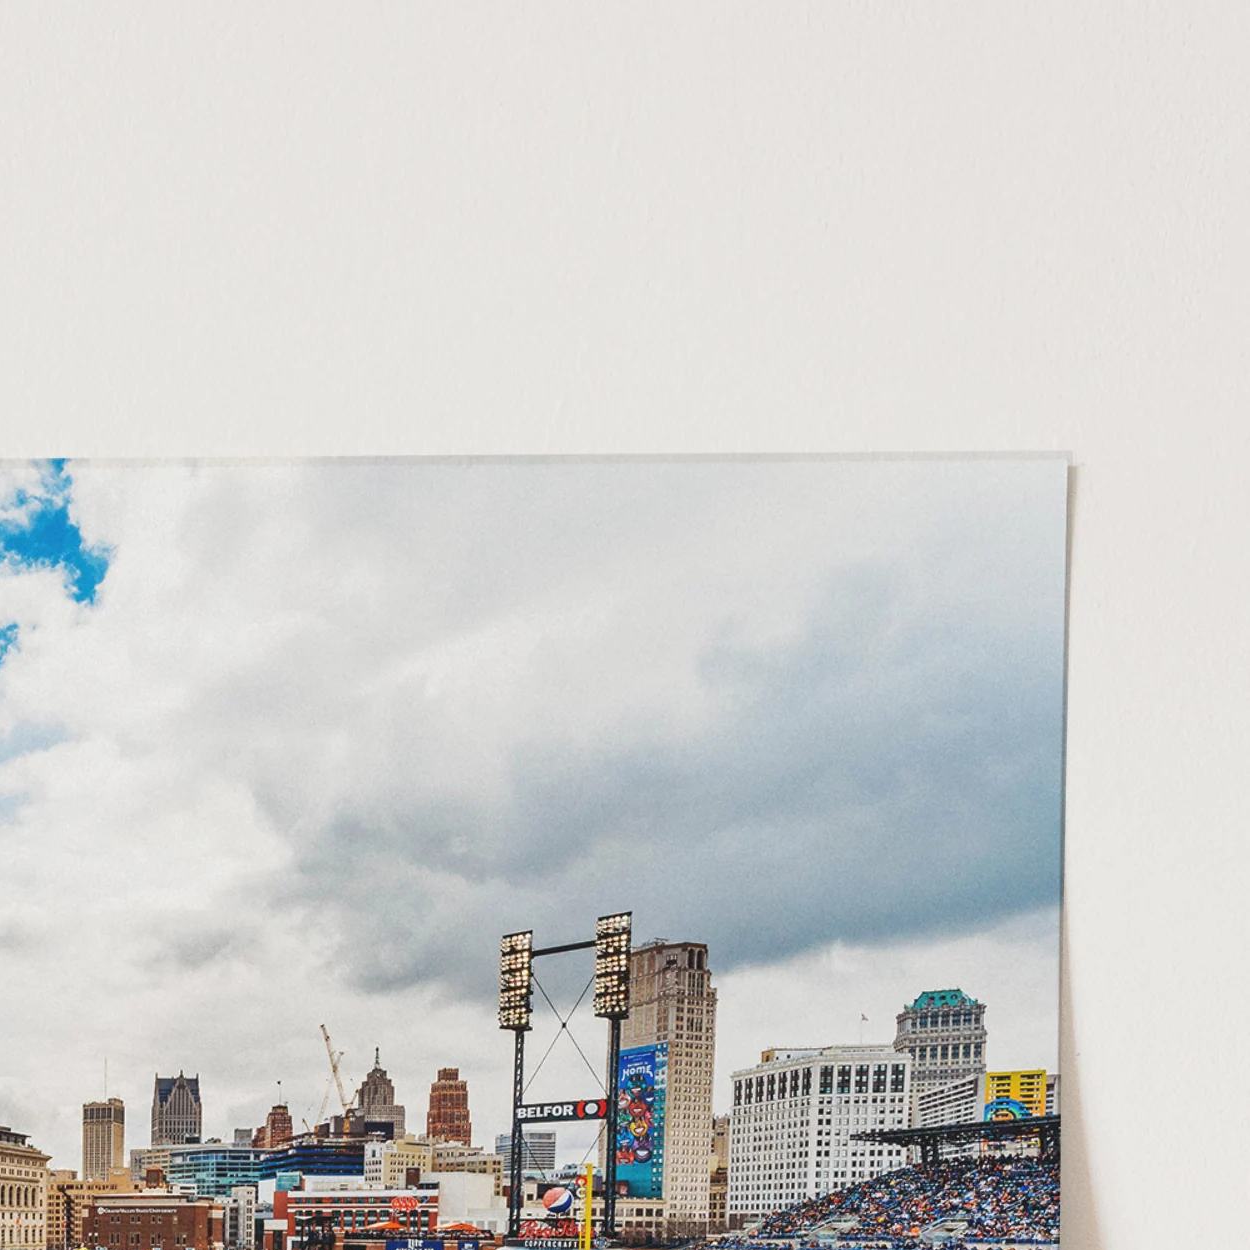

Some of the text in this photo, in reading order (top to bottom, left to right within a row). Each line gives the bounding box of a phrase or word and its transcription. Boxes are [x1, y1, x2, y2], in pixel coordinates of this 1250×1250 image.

[621, 1064, 654, 1082] HOME
[516, 1104, 574, 1119] BELFOR
[518, 1220, 554, 1241] Pepsi
[524, 1240, 578, 1248] COPPERCRAFT
